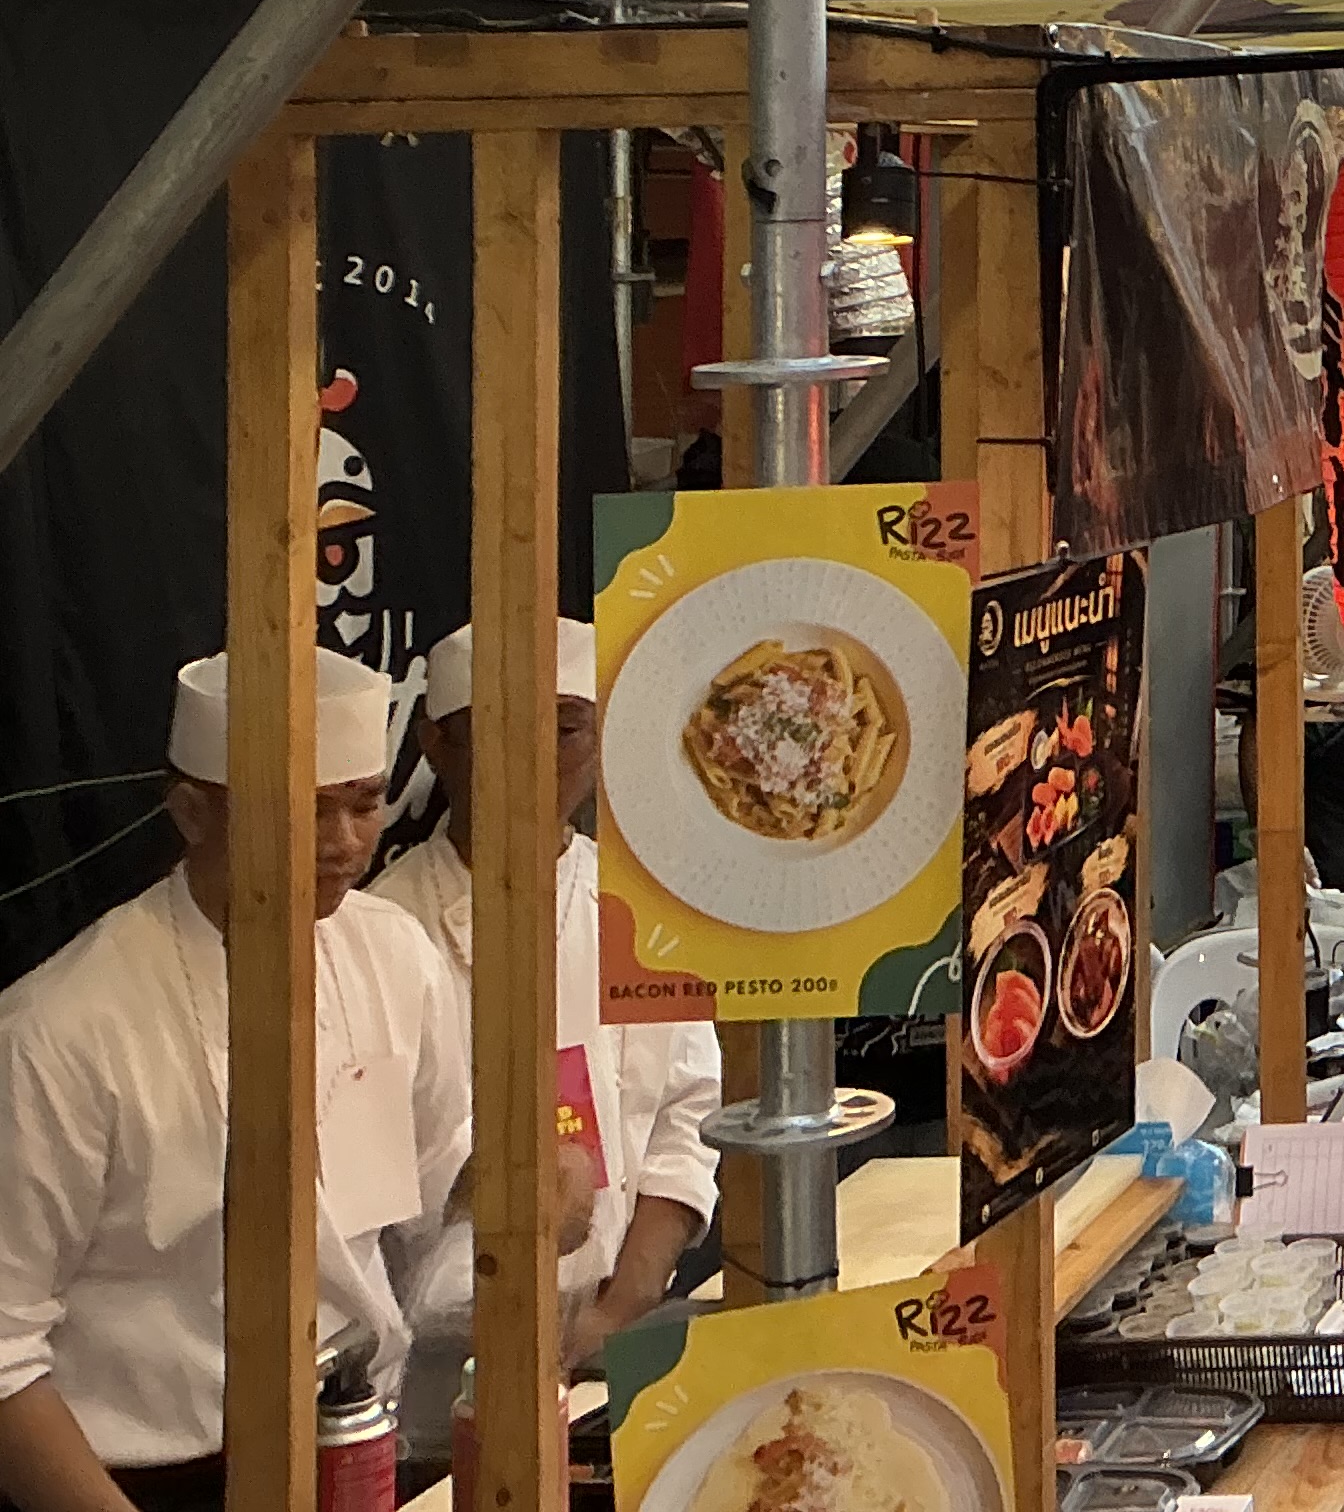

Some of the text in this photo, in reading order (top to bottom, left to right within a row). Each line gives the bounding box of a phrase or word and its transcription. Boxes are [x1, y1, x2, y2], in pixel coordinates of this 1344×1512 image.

[1013, 571, 1116, 655] เมนูแนะนำ
[608, 982, 677, 1000] BACON
[684, 980, 718, 997] RED
[724, 978, 783, 995] PESTO
